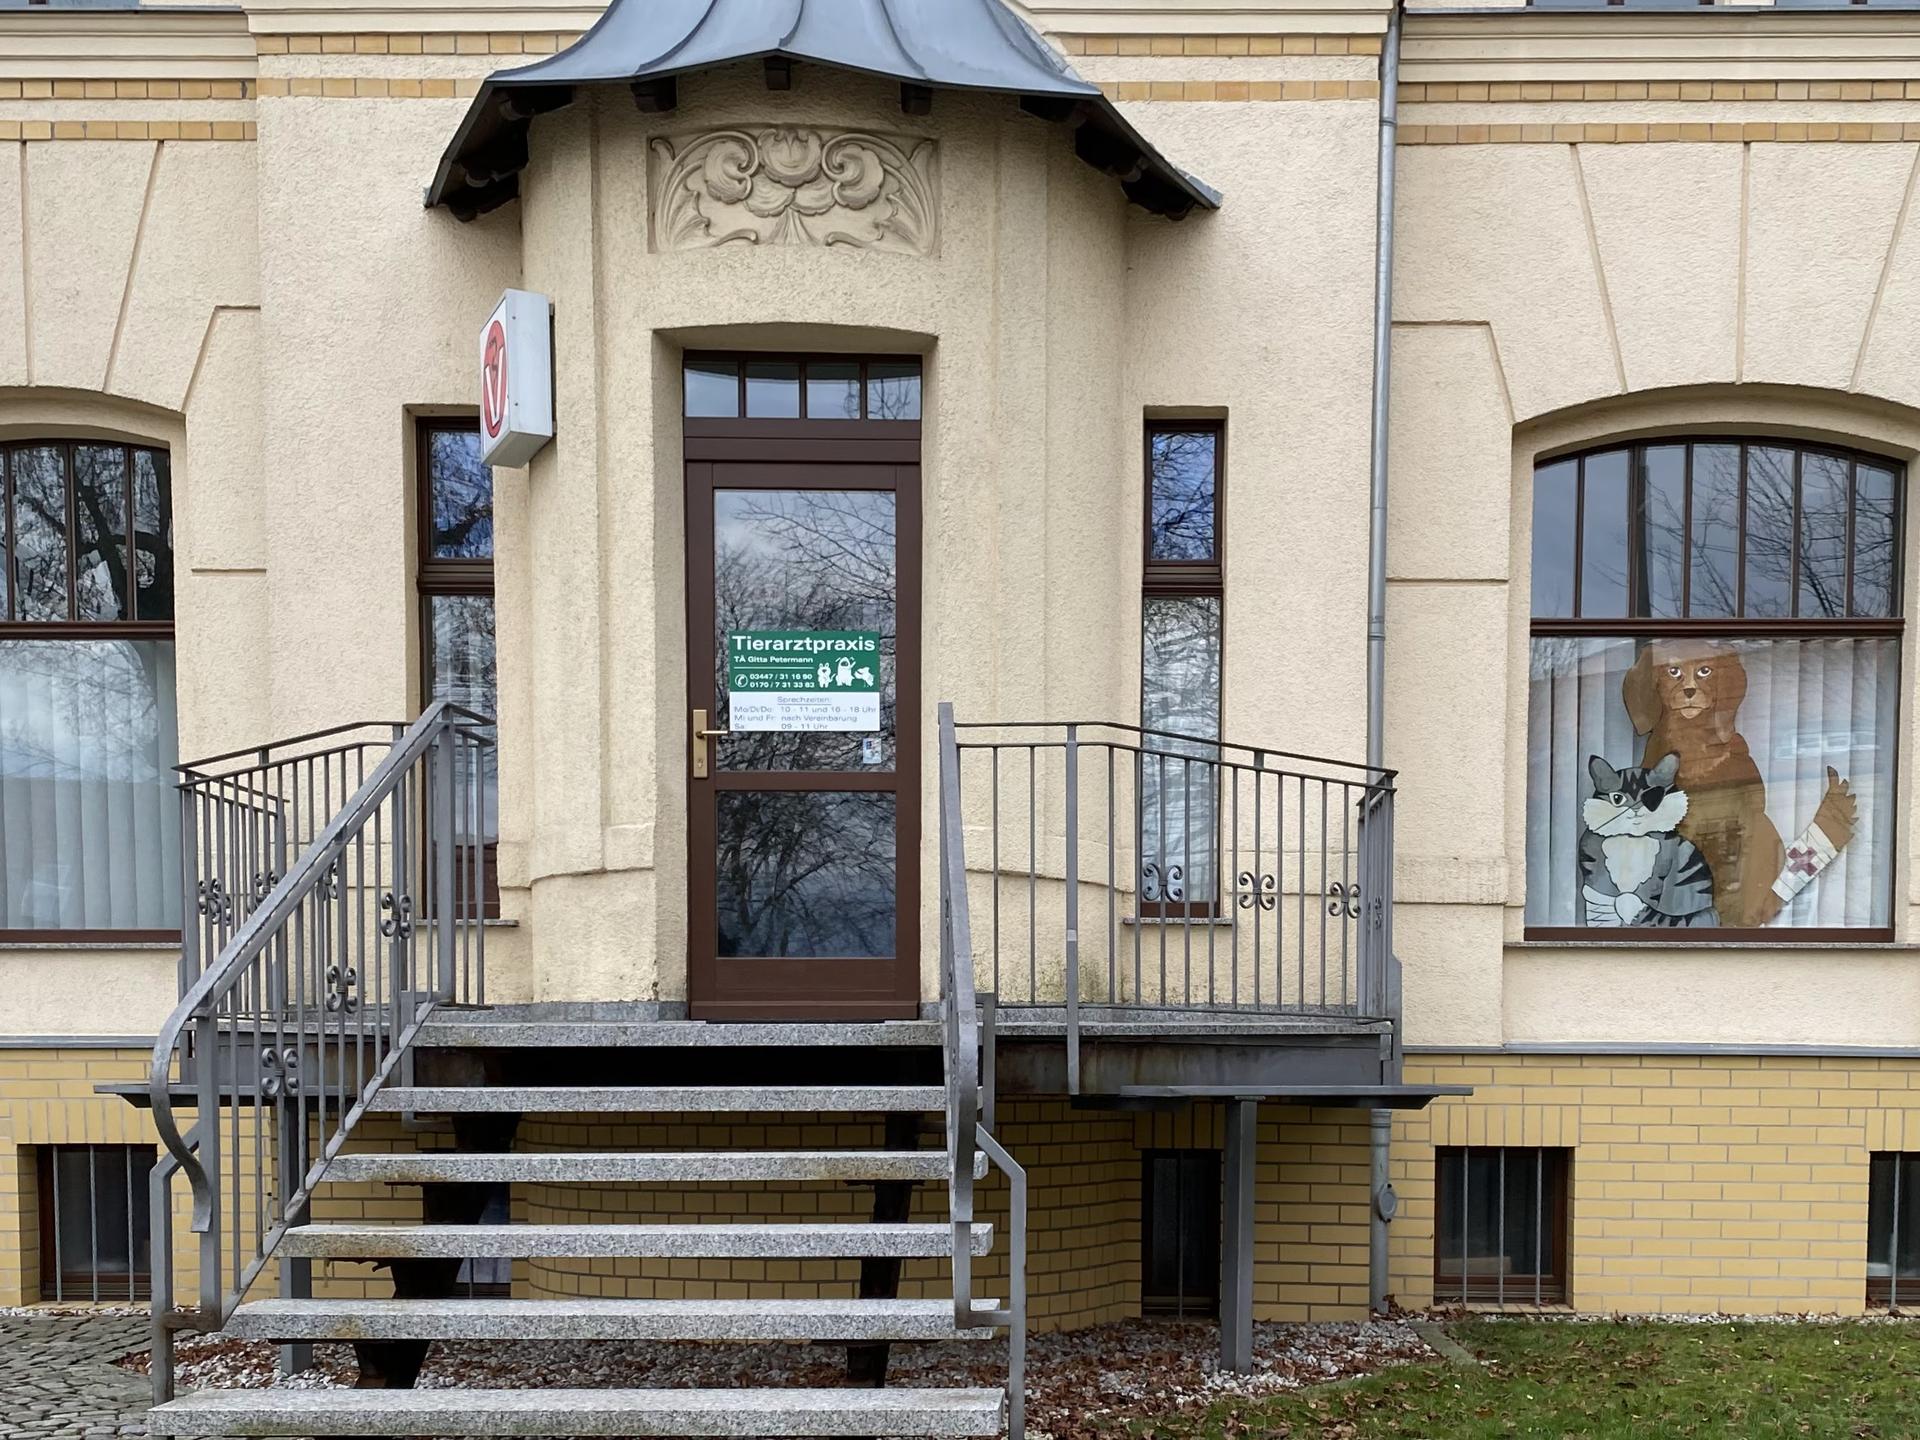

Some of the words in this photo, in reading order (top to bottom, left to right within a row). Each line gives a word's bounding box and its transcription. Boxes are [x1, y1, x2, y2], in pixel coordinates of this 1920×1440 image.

[731, 635, 876, 654] Tierarztpraxis
[747, 655, 768, 663] Gitta
[769, 655, 814, 663] Petermann
[803, 714, 858, 723] Vereinbarung
